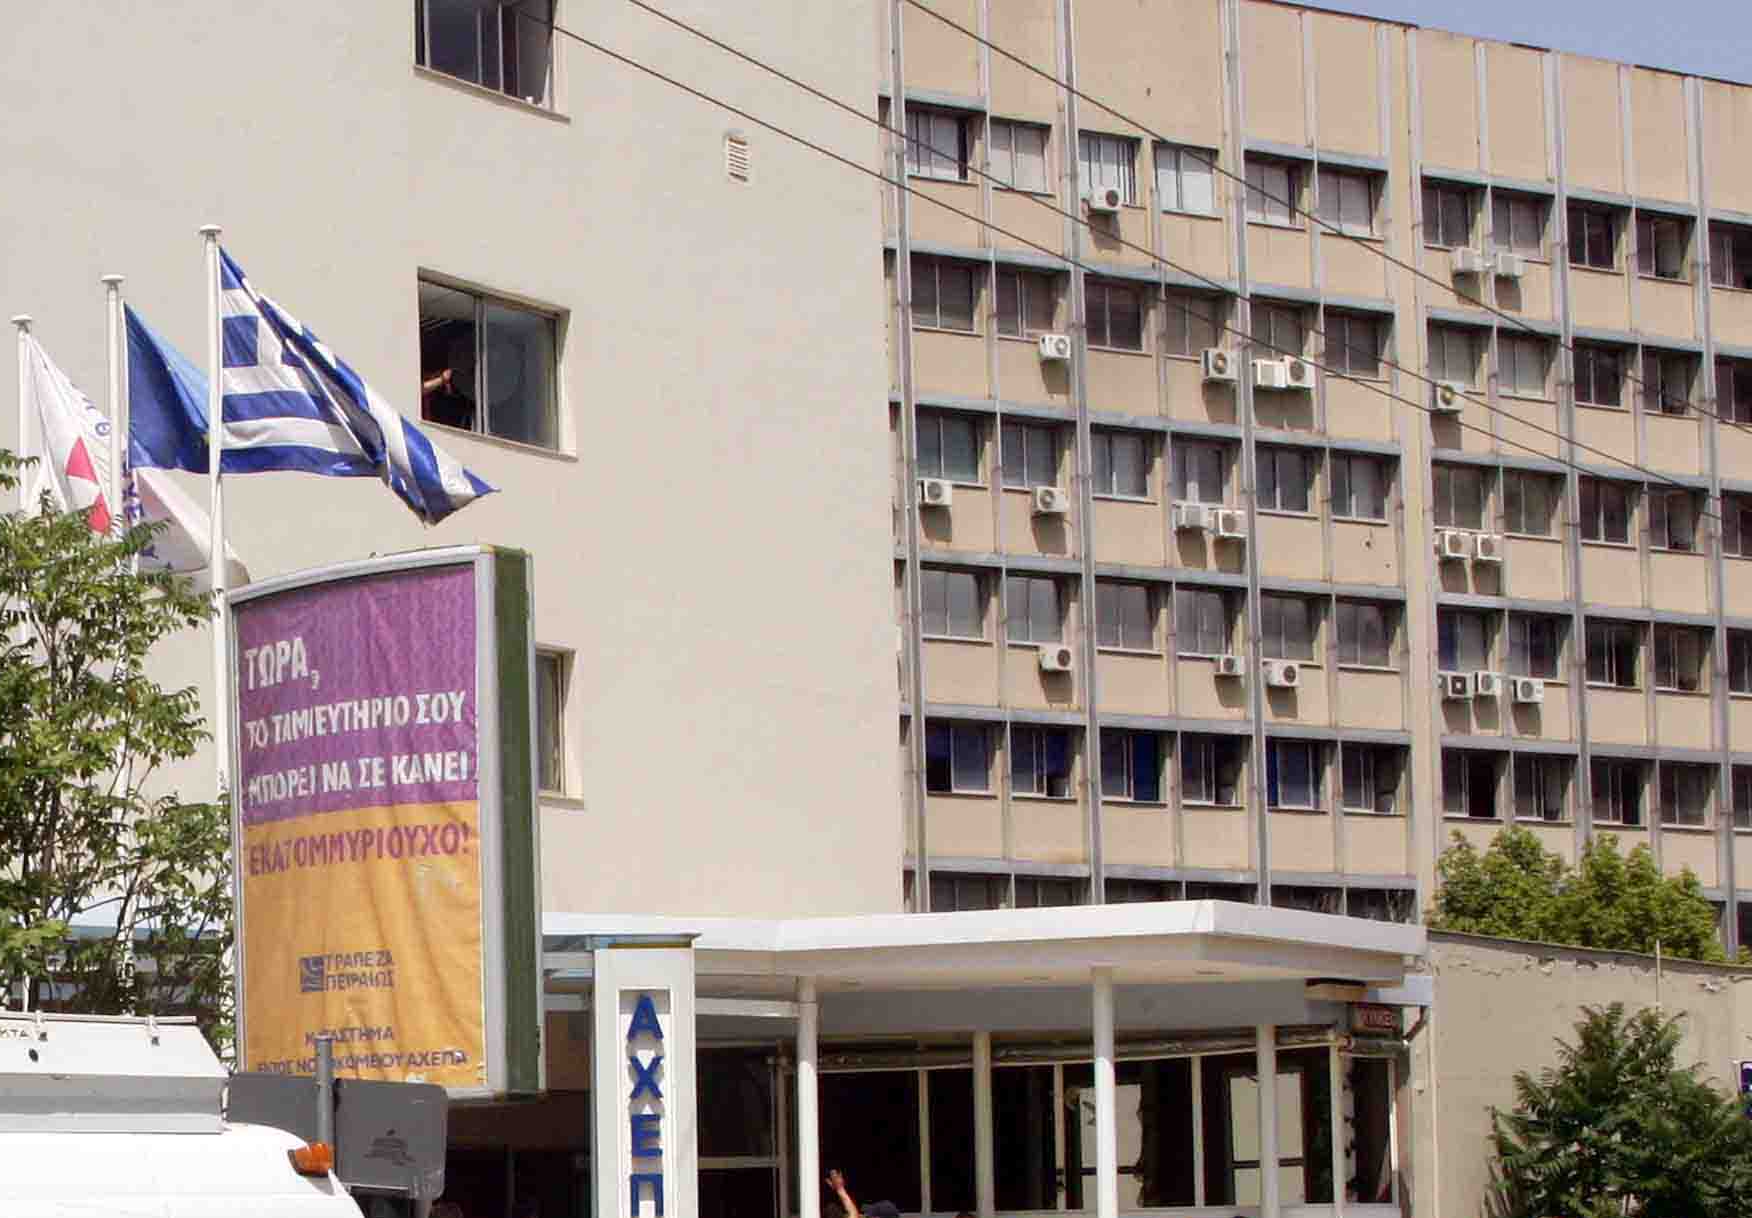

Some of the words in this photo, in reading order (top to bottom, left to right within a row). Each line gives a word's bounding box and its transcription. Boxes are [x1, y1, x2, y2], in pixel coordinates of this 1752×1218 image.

[246, 637, 320, 690] ΤΩΡΑ,
[246, 718, 268, 750] ΤΟ
[272, 696, 410, 744] ΤΑΜΙΕΥΤΗΡΙΟ
[416, 691, 465, 724] ΣΟΥ
[248, 765, 315, 806] ΜΠΟΡΕΙ
[322, 762, 352, 792] ΝΑ
[358, 757, 385, 787] ΣΕ
[392, 751, 468, 784] ΚΑΝΕΙ
[249, 821, 470, 876] ΕΚΑΤΟΜΜΥΡΙΟΥΧΟ!
[326, 951, 392, 971] ΤΡΑΠΕΖΑ
[326, 970, 392, 990] ΠΕΙΡΑΙΩΣ
[407, 1049, 466, 1067] ΑΧΕΠΑ
